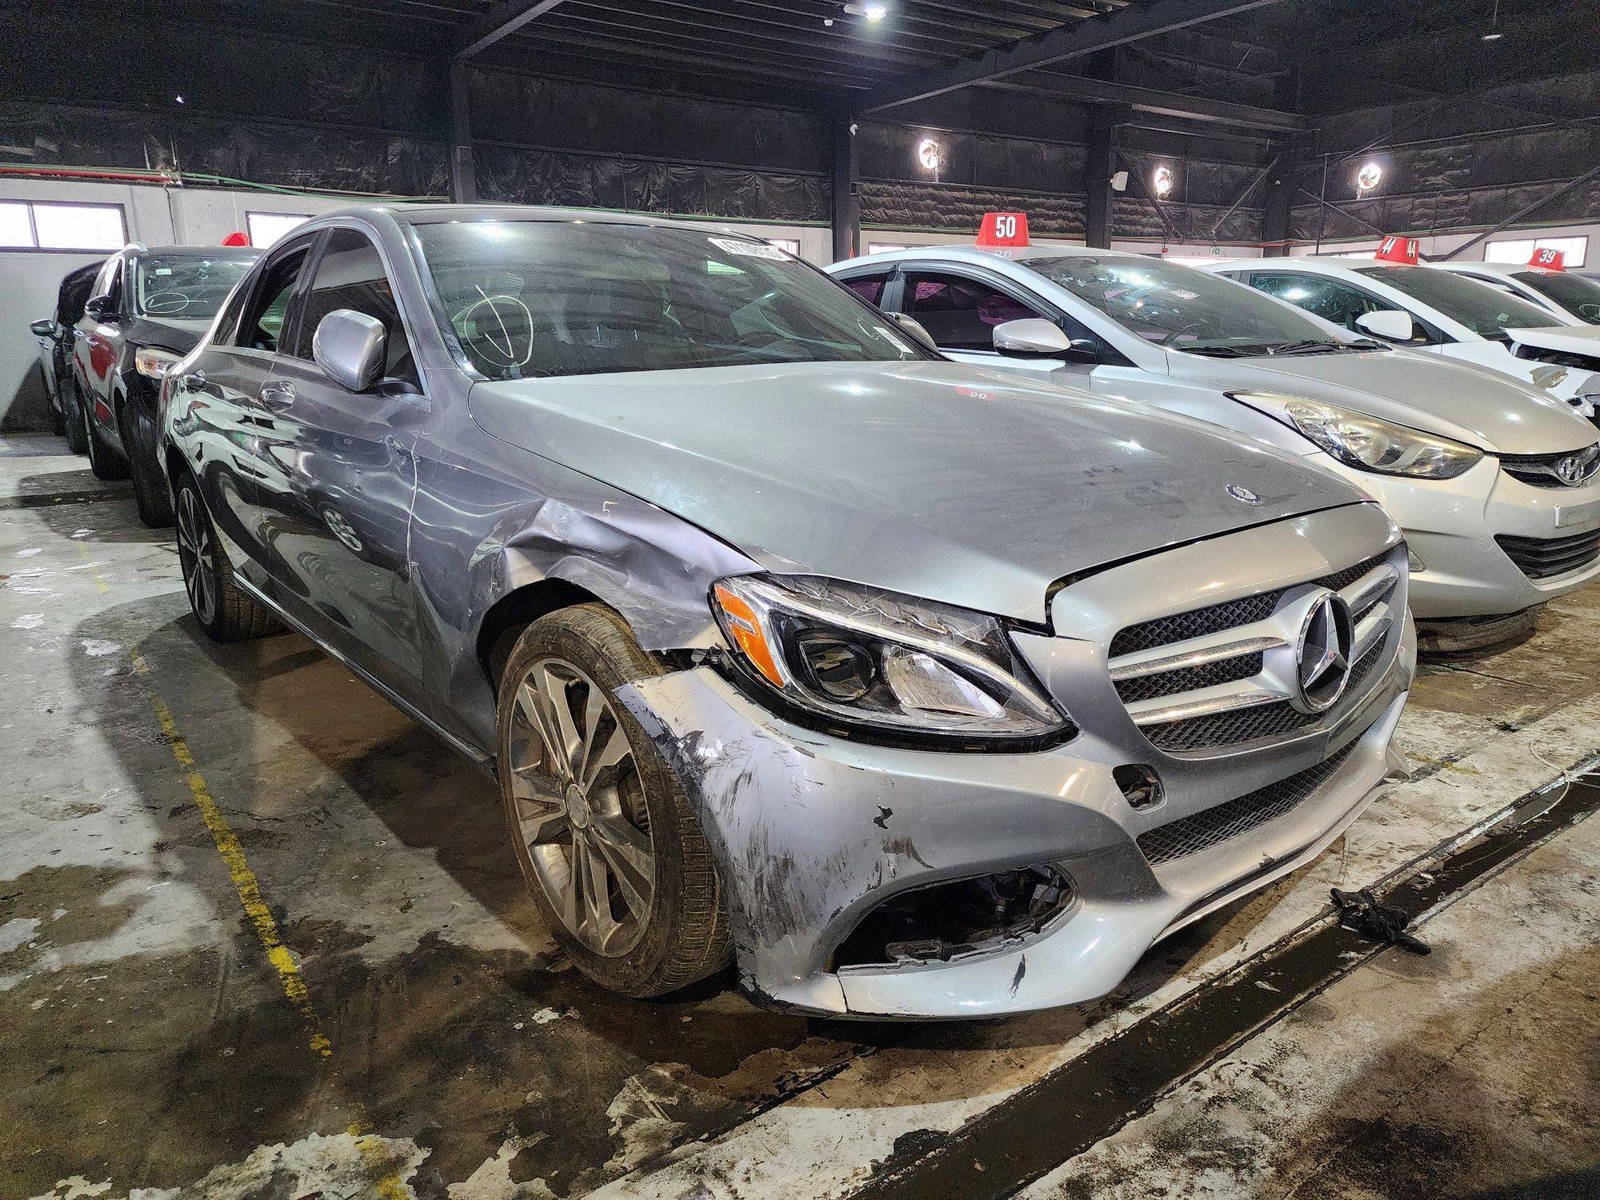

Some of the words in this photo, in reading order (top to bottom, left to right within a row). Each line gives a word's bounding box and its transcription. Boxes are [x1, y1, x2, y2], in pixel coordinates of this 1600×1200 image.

[995, 216, 1016, 238] 50
[1381, 237, 1397, 254] 44
[1406, 240, 1416, 258] 44
[1540, 250, 1556, 264] 39
